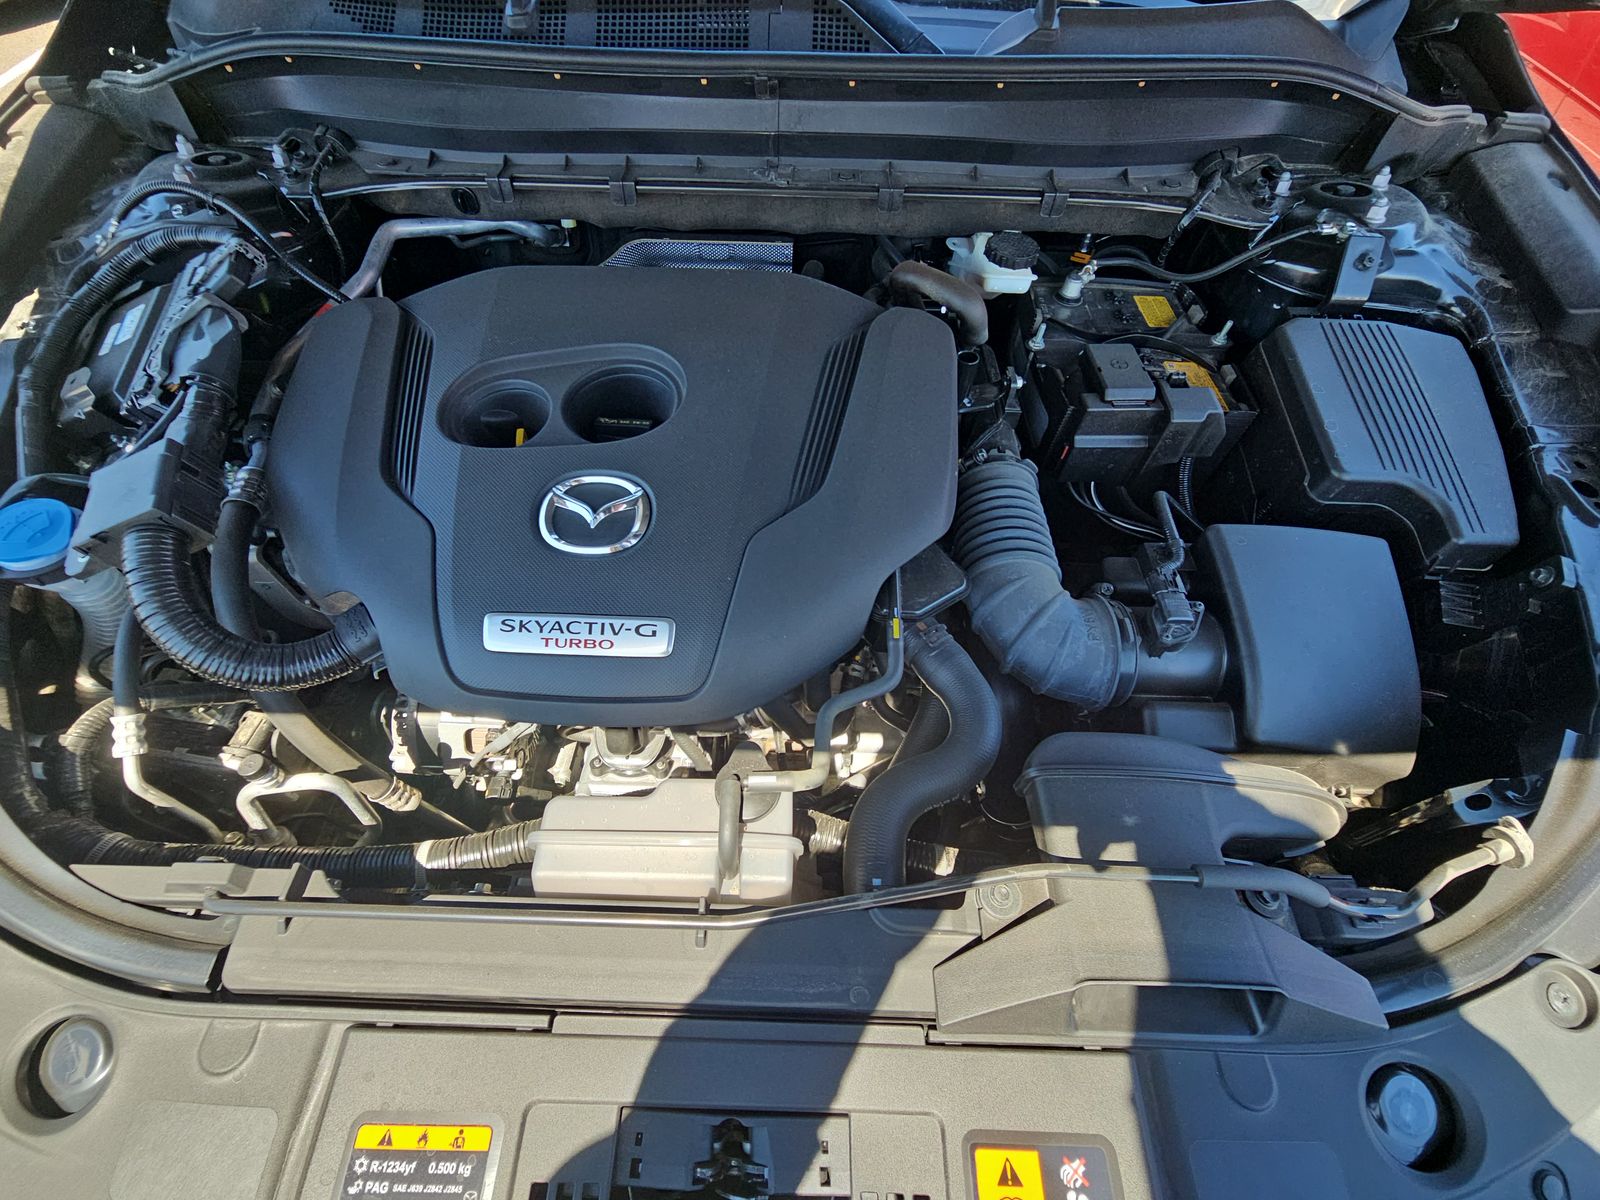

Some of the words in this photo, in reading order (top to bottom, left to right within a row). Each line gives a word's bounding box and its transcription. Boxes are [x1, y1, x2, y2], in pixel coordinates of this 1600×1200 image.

[499, 618, 658, 638] SKYACTIV-G
[540, 637, 614, 650] TURBO
[369, 1160, 417, 1176] R-1234yf
[428, 1162, 457, 1175] 0.500
[457, 1162, 472, 1177] kg
[364, 1181, 389, 1194] PAG
[392, 1183, 407, 1193] SAE
